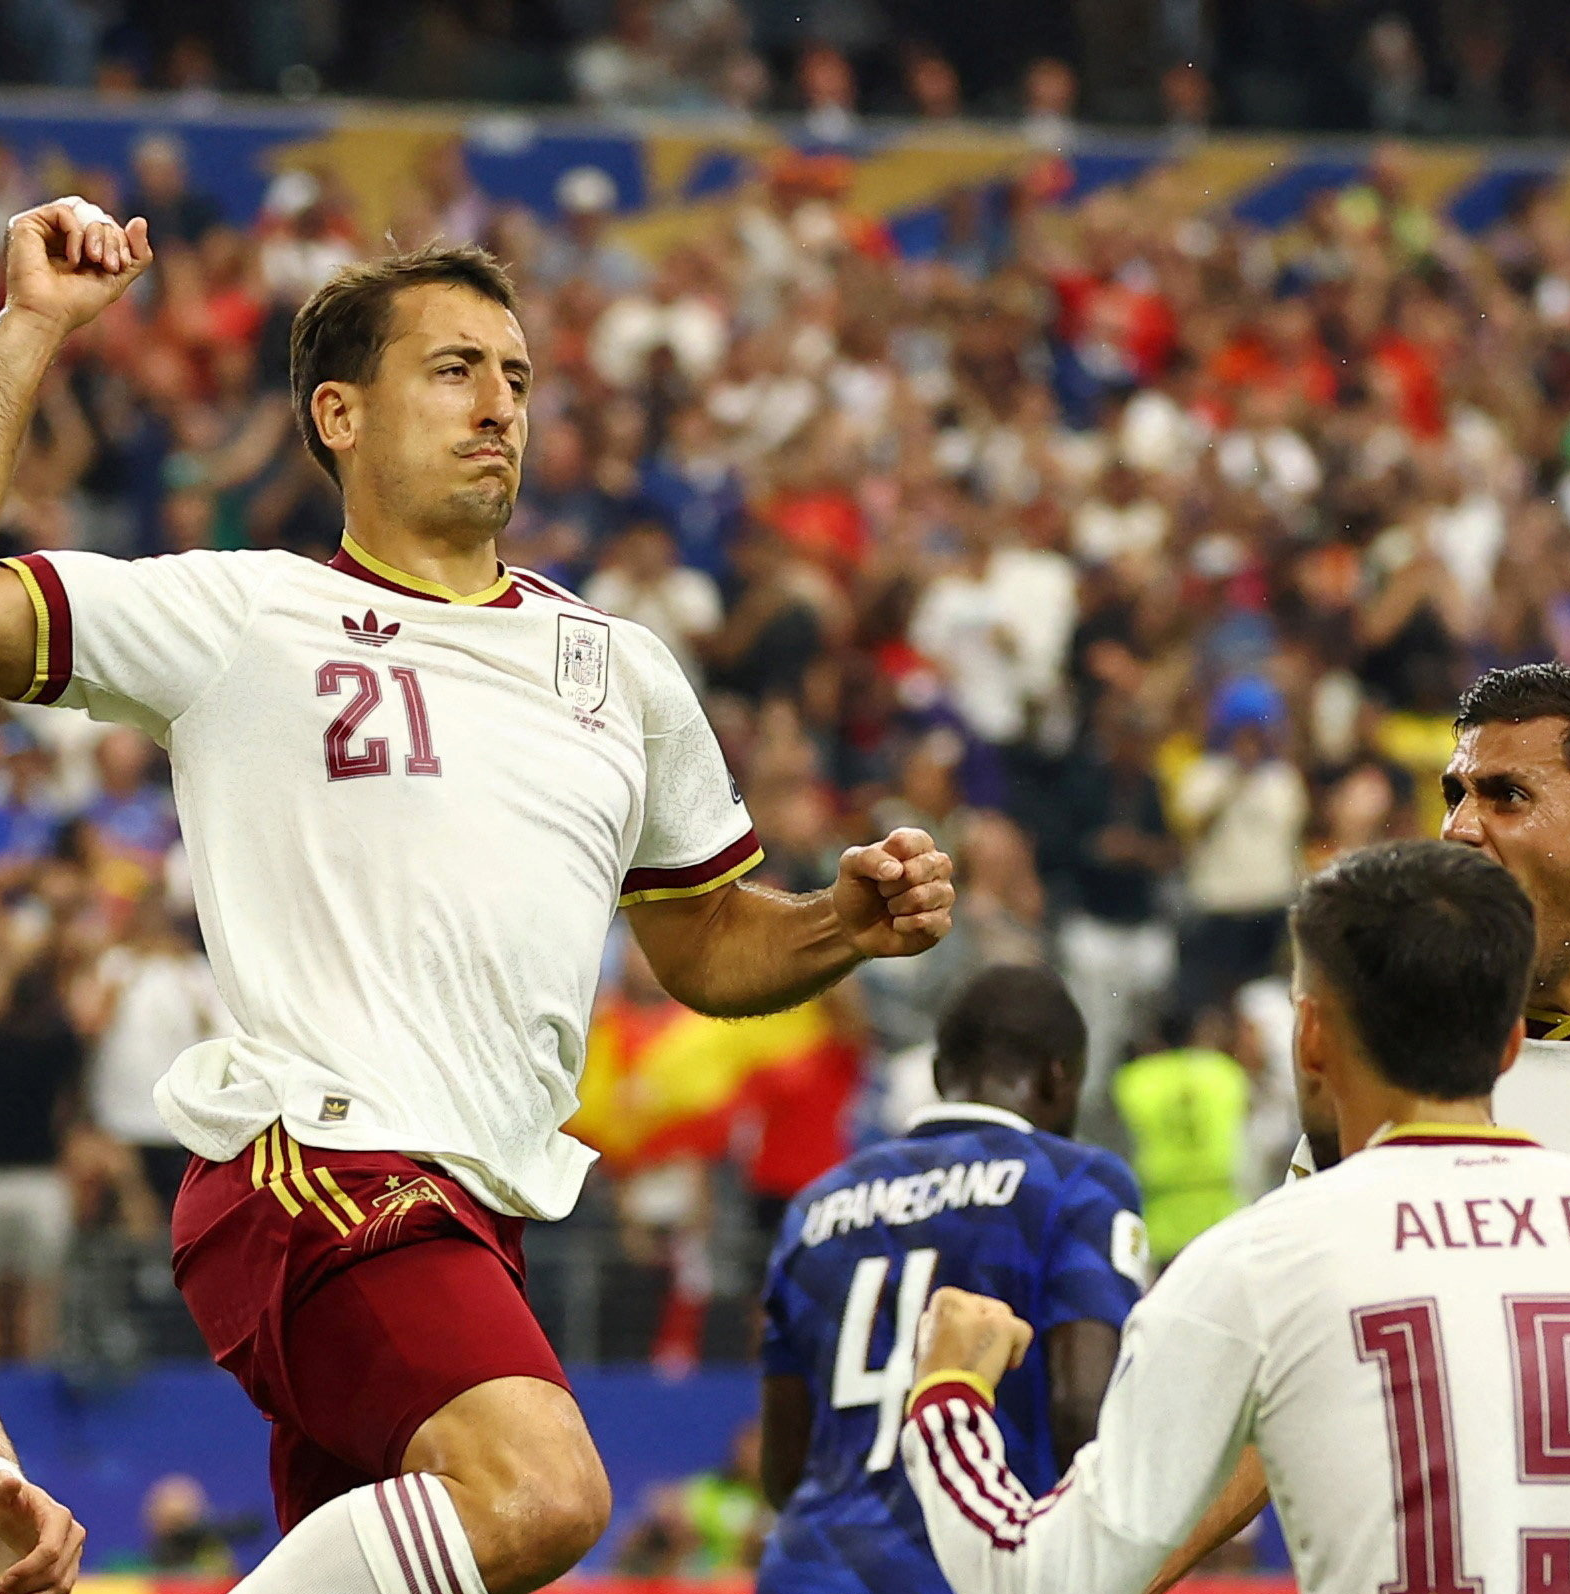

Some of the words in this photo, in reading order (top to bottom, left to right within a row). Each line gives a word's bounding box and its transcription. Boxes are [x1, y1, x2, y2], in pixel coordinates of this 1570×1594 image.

[315, 659, 442, 782] 21
[801, 1158, 1027, 1248] UPAMECANO
[1395, 1197, 1547, 1250] ALEX
[831, 1247, 939, 1473] 4
